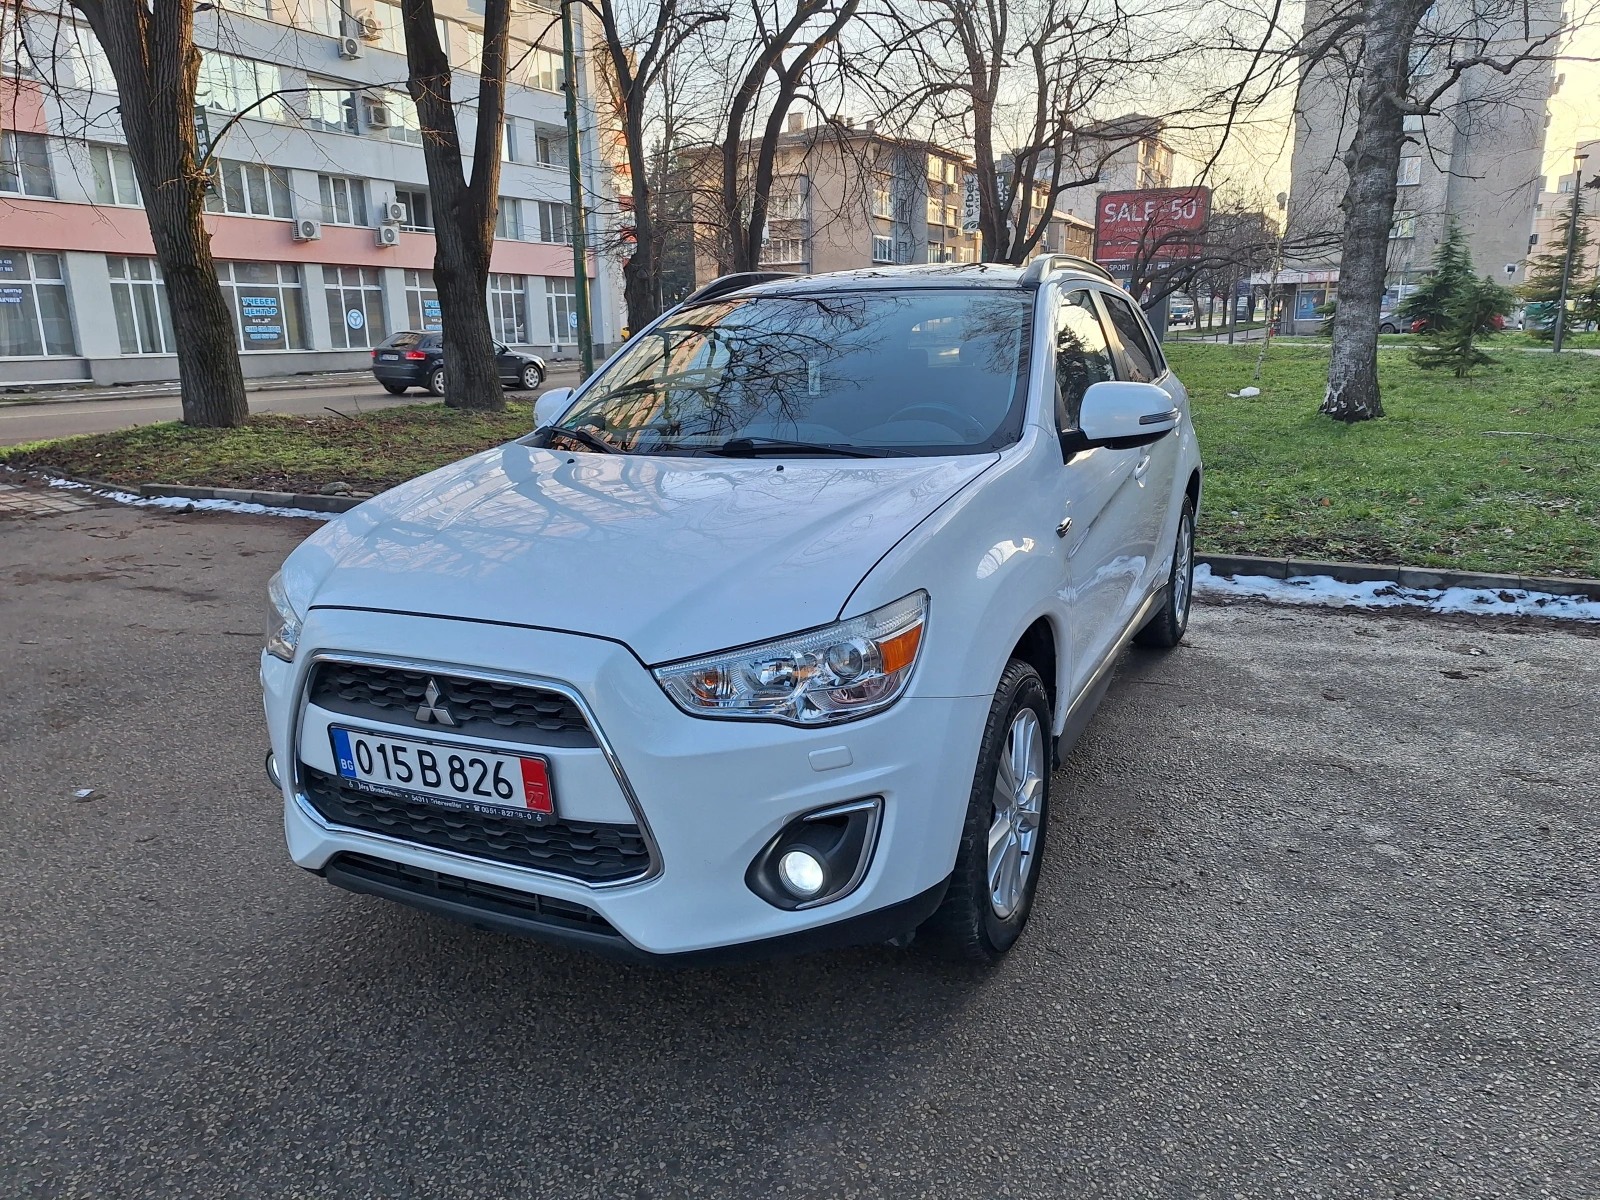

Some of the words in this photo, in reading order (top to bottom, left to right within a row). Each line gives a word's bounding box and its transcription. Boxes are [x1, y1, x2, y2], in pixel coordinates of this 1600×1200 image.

[965, 178, 974, 217] efbet
[1104, 200, 1156, 223] SALE
[1108, 263, 1130, 272] SPORT
[241, 297, 277, 306] УЧЕБЕН
[243, 307, 277, 317] ЦЕНТЪР
[340, 758, 354, 771] BG
[527, 790, 545, 804] 27
